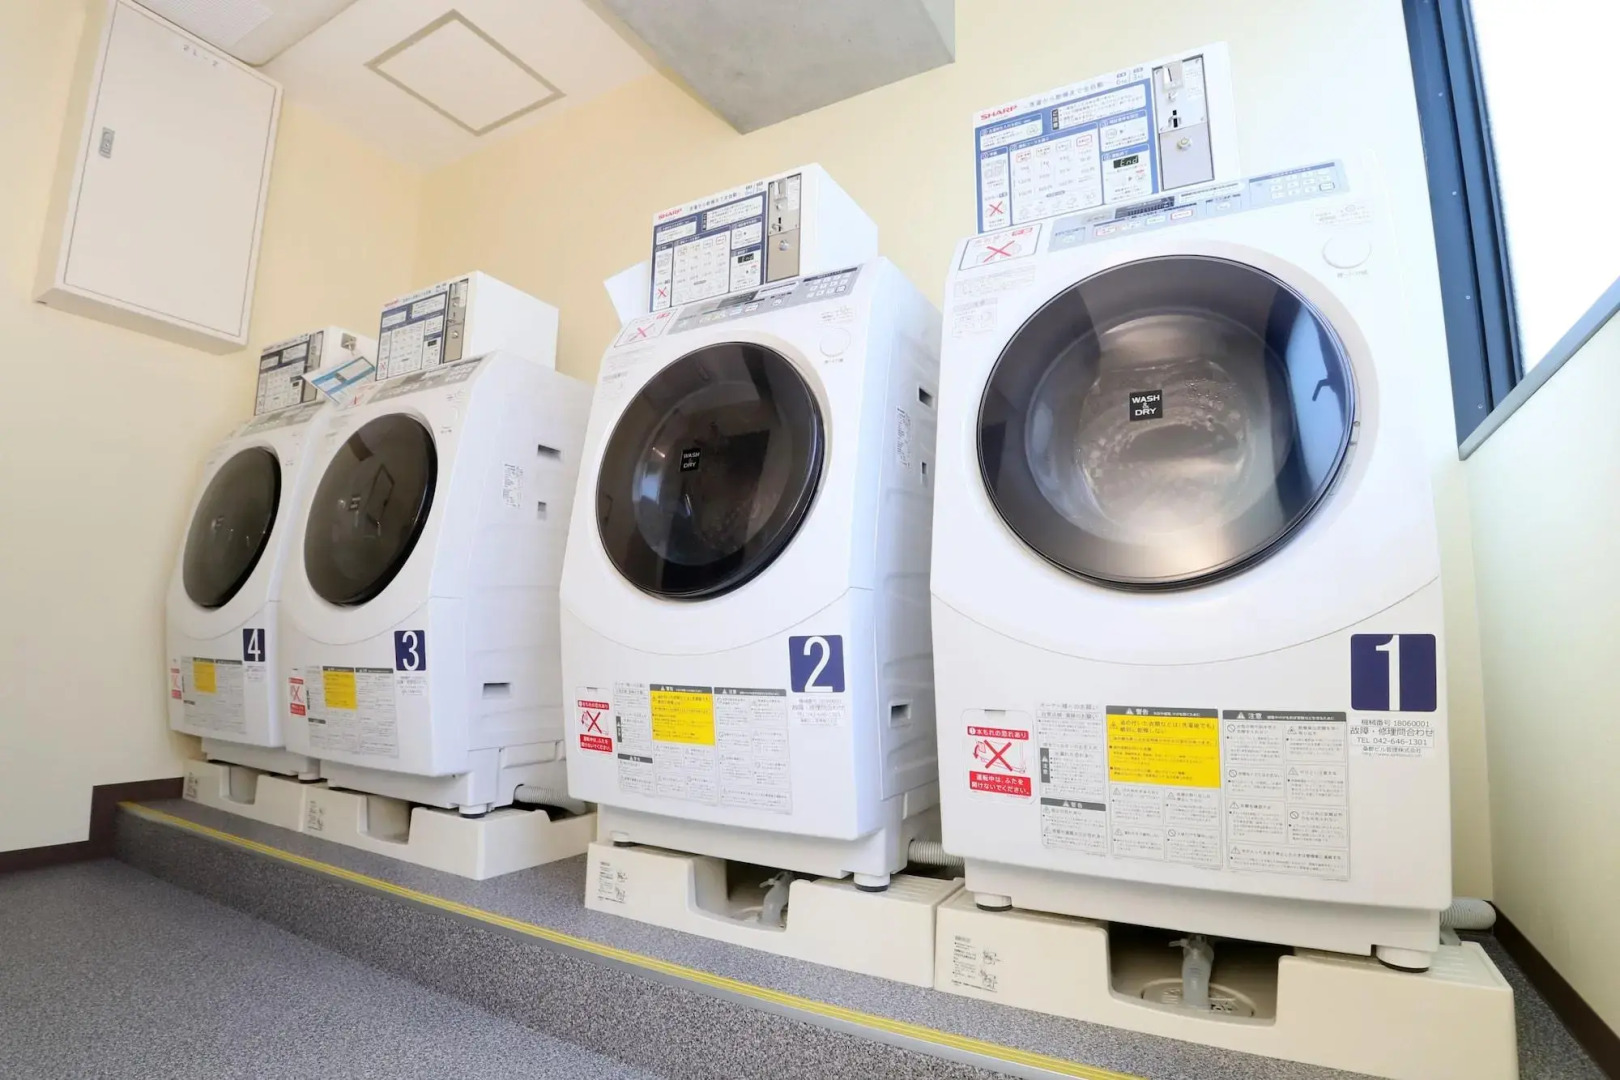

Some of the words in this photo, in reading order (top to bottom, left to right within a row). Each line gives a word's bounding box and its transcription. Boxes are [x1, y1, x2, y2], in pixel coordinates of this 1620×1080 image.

[980, 104, 1018, 121] SHARP
[1131, 394, 1160, 404] WASH
[1134, 407, 1157, 416] DRY
[247, 628, 261, 662] 4
[401, 630, 420, 671] 3
[803, 635, 834, 693] 2
[1375, 634, 1401, 711] 1
[976, 729, 1026, 738] 水もれの恐れあり
[1373, 737, 1427, 746] 042-646-1301
[976, 773, 1023, 785] 運転中は、ふたを
